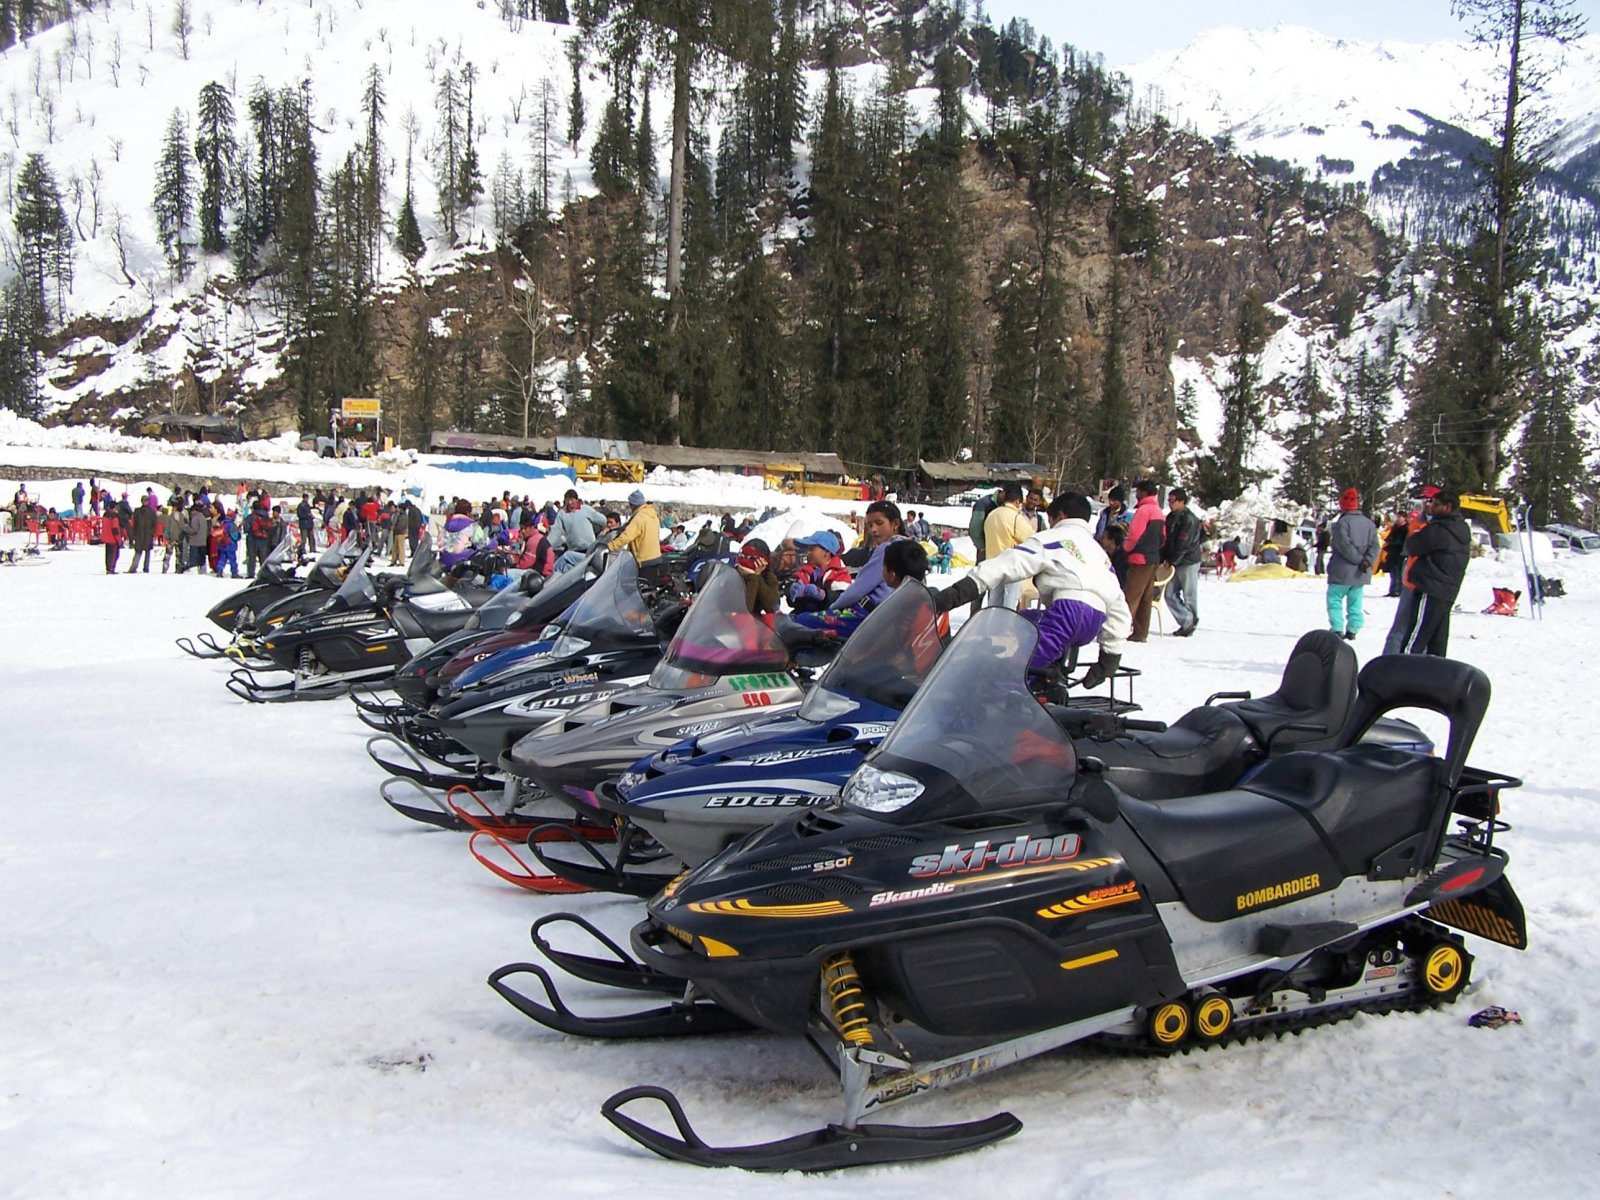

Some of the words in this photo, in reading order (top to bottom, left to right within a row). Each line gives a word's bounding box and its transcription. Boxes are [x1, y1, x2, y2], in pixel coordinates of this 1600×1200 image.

[728, 673, 790, 691] SPORTS
[527, 692, 593, 711] EDGE
[676, 720, 722, 737] SPORT
[752, 749, 814, 765] TRAIL
[704, 795, 801, 808] EDGE
[908, 833, 1083, 878] ski-doo
[868, 881, 956, 909] Skandic
[1237, 873, 1321, 911] BOMBARDIER
